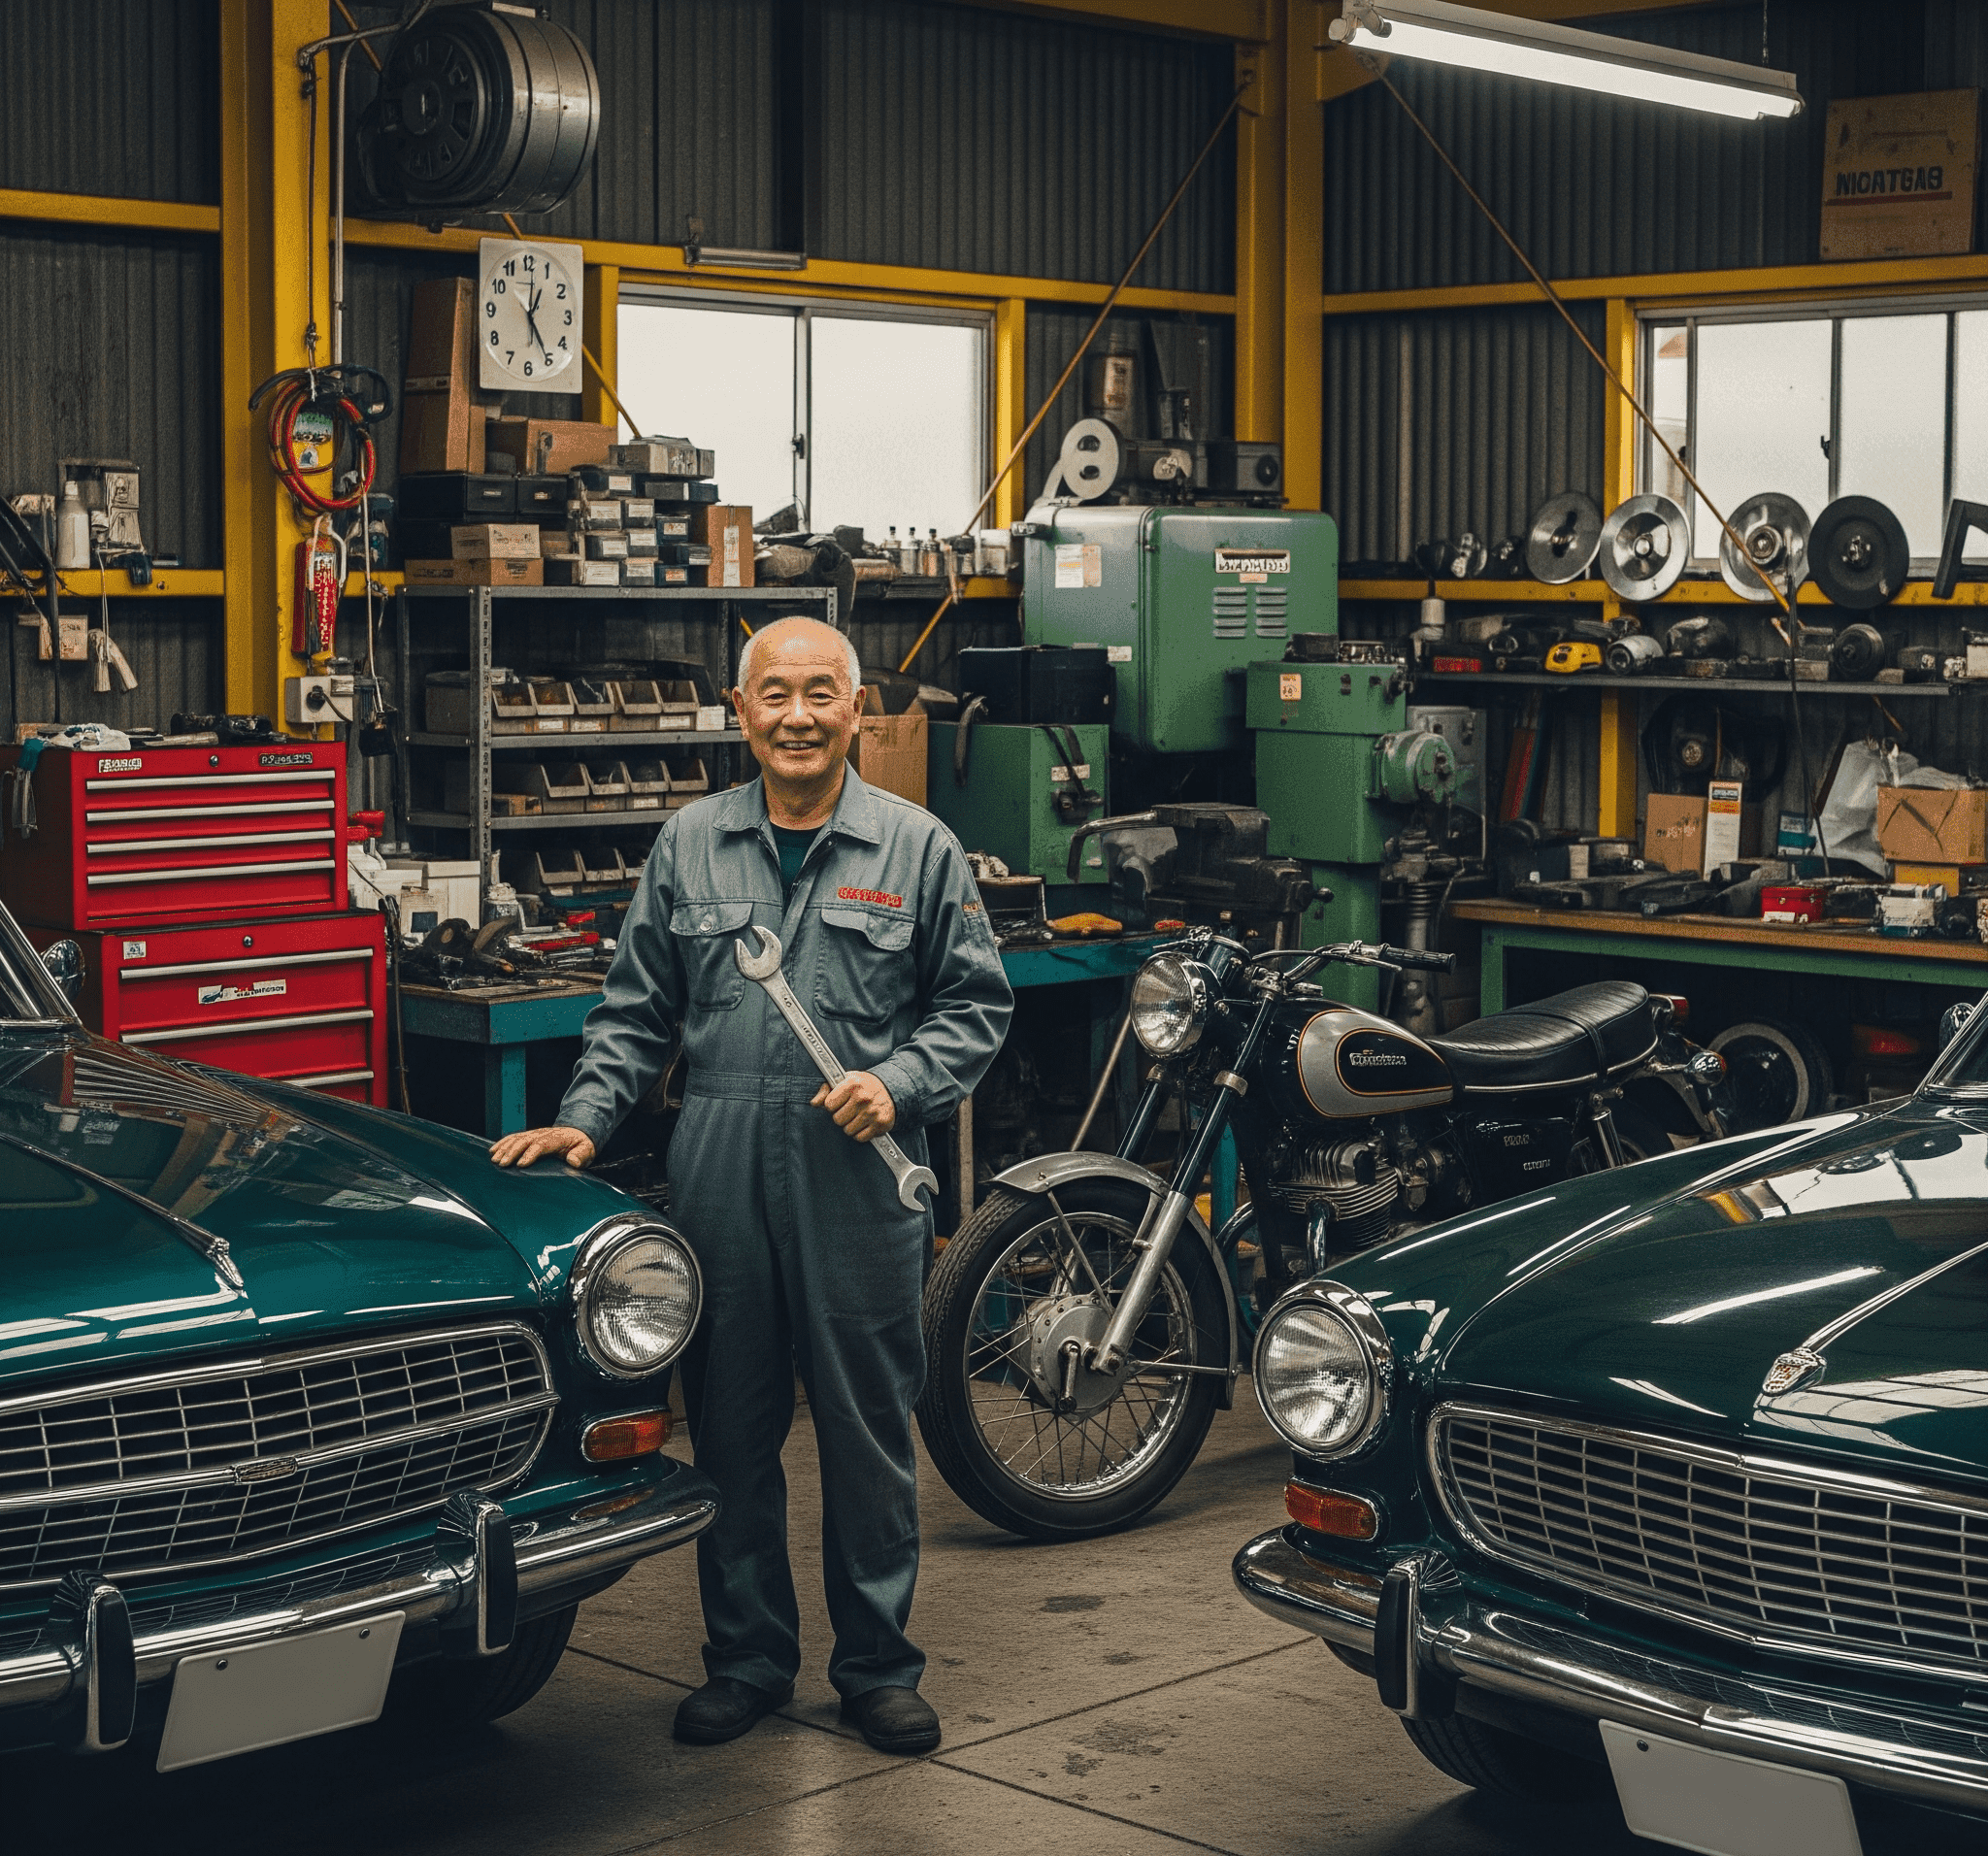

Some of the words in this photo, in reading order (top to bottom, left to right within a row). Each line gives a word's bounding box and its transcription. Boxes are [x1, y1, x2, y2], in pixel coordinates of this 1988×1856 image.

[503, 259, 515, 276] 11
[523, 255, 535, 272] 12
[545, 262, 550, 280] 1
[492, 278, 507, 294] 10
[556, 282, 566, 300] 2
[486, 301, 496, 318] 9
[563, 310, 572, 326] 3
[490, 330, 499, 346] 8
[557, 336, 567, 350] 4
[506, 350, 514, 366] 7
[523, 360, 533, 377] 6
